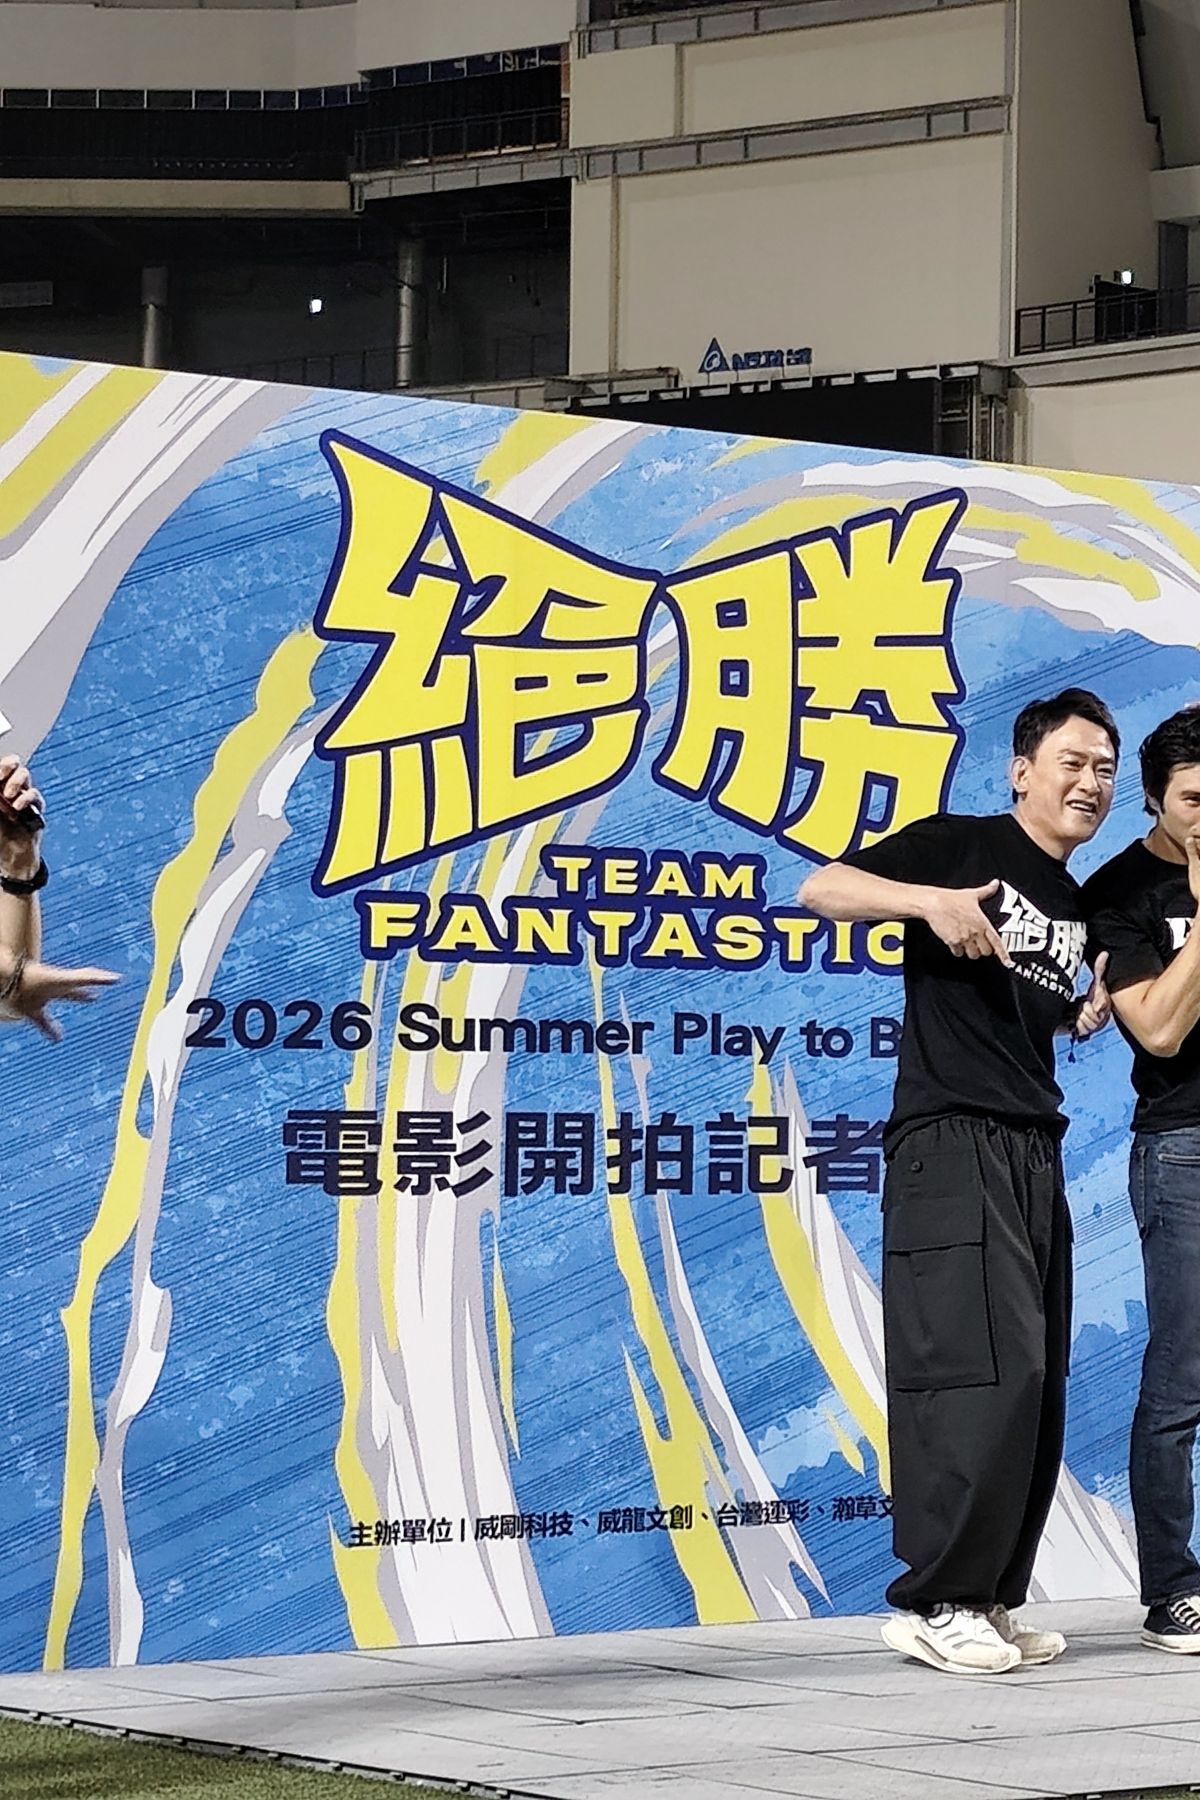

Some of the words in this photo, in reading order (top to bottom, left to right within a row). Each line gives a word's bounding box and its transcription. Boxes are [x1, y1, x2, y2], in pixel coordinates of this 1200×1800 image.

[551, 855, 759, 900] TEAM
[362, 901, 905, 968] FANTASTIC
[184, 999, 373, 1050] 2026
[398, 1002, 655, 1056] Summer
[673, 1011, 787, 1066] Play
[800, 1019, 855, 1058] to
[282, 1109, 888, 1198] 電影開拍記者
